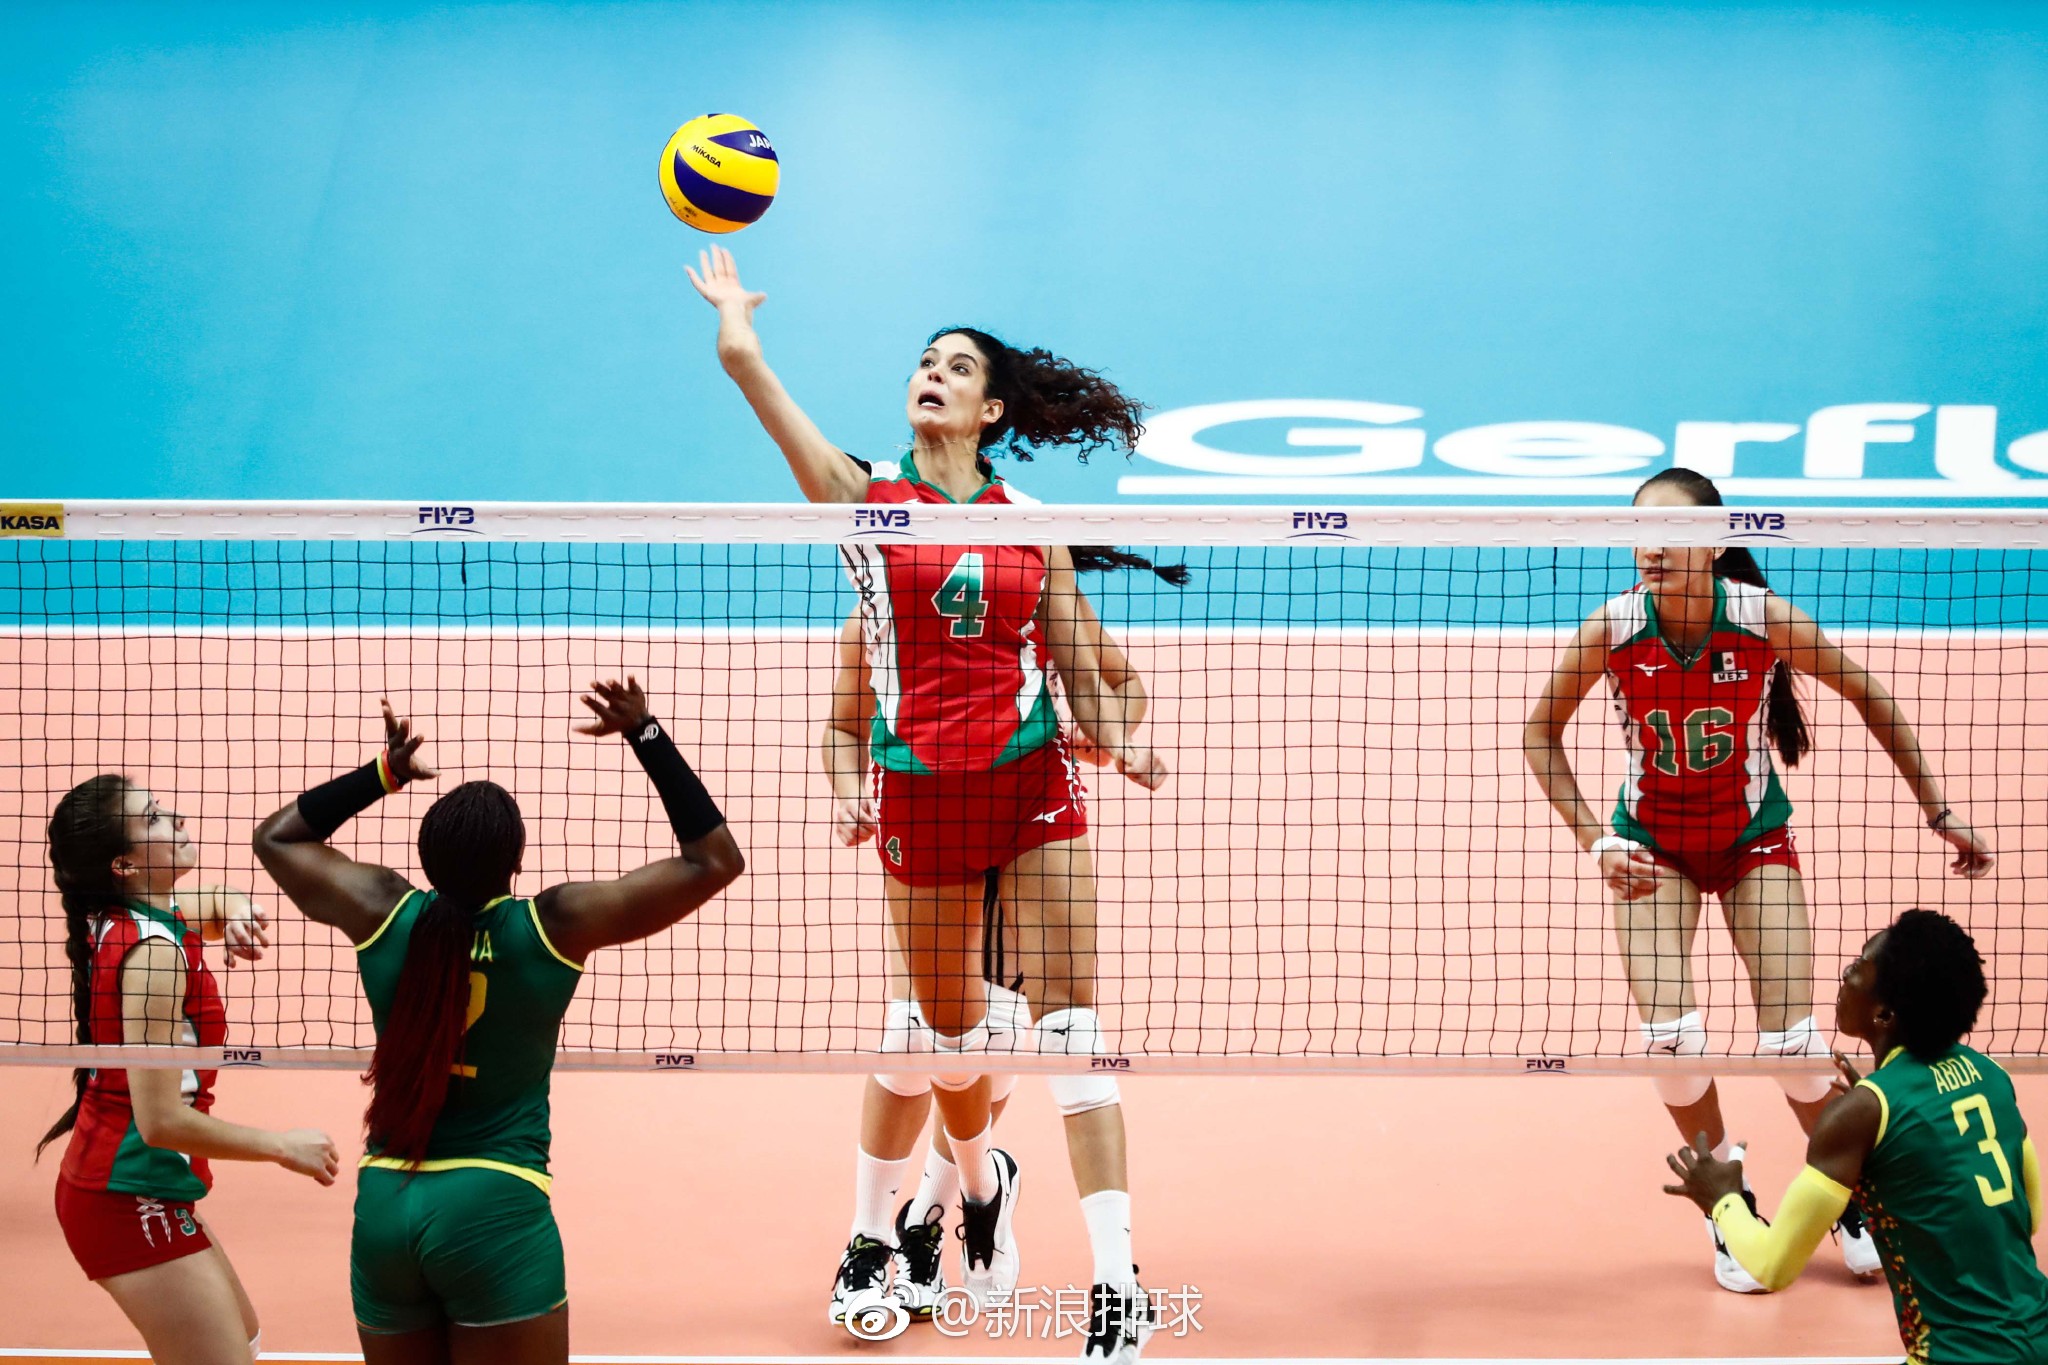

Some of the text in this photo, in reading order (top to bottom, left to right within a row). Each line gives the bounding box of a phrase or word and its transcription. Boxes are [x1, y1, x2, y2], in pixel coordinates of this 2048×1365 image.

[748, 134, 774, 150] JAP
[690, 144, 722, 168] MIKASA
[1138, 400, 2048, 479] Gerfl
[419, 507, 474, 524] FIVB
[856, 509, 911, 527] FIVB
[1293, 512, 1349, 529] FIVB
[1729, 513, 1785, 530] FIVB
[931, 552, 988, 639] 4
[1717, 671, 1743, 682] MEX
[1644, 706, 1733, 776] 16
[886, 835, 902, 867] 4
[223, 1050, 262, 1061] FIVB
[655, 1054, 694, 1065] FIVB
[1091, 1058, 1130, 1068] FIVB
[1526, 1059, 1565, 1069] FIVB
[1951, 1093, 2014, 1207] 3
[175, 1208, 196, 1237] 3
